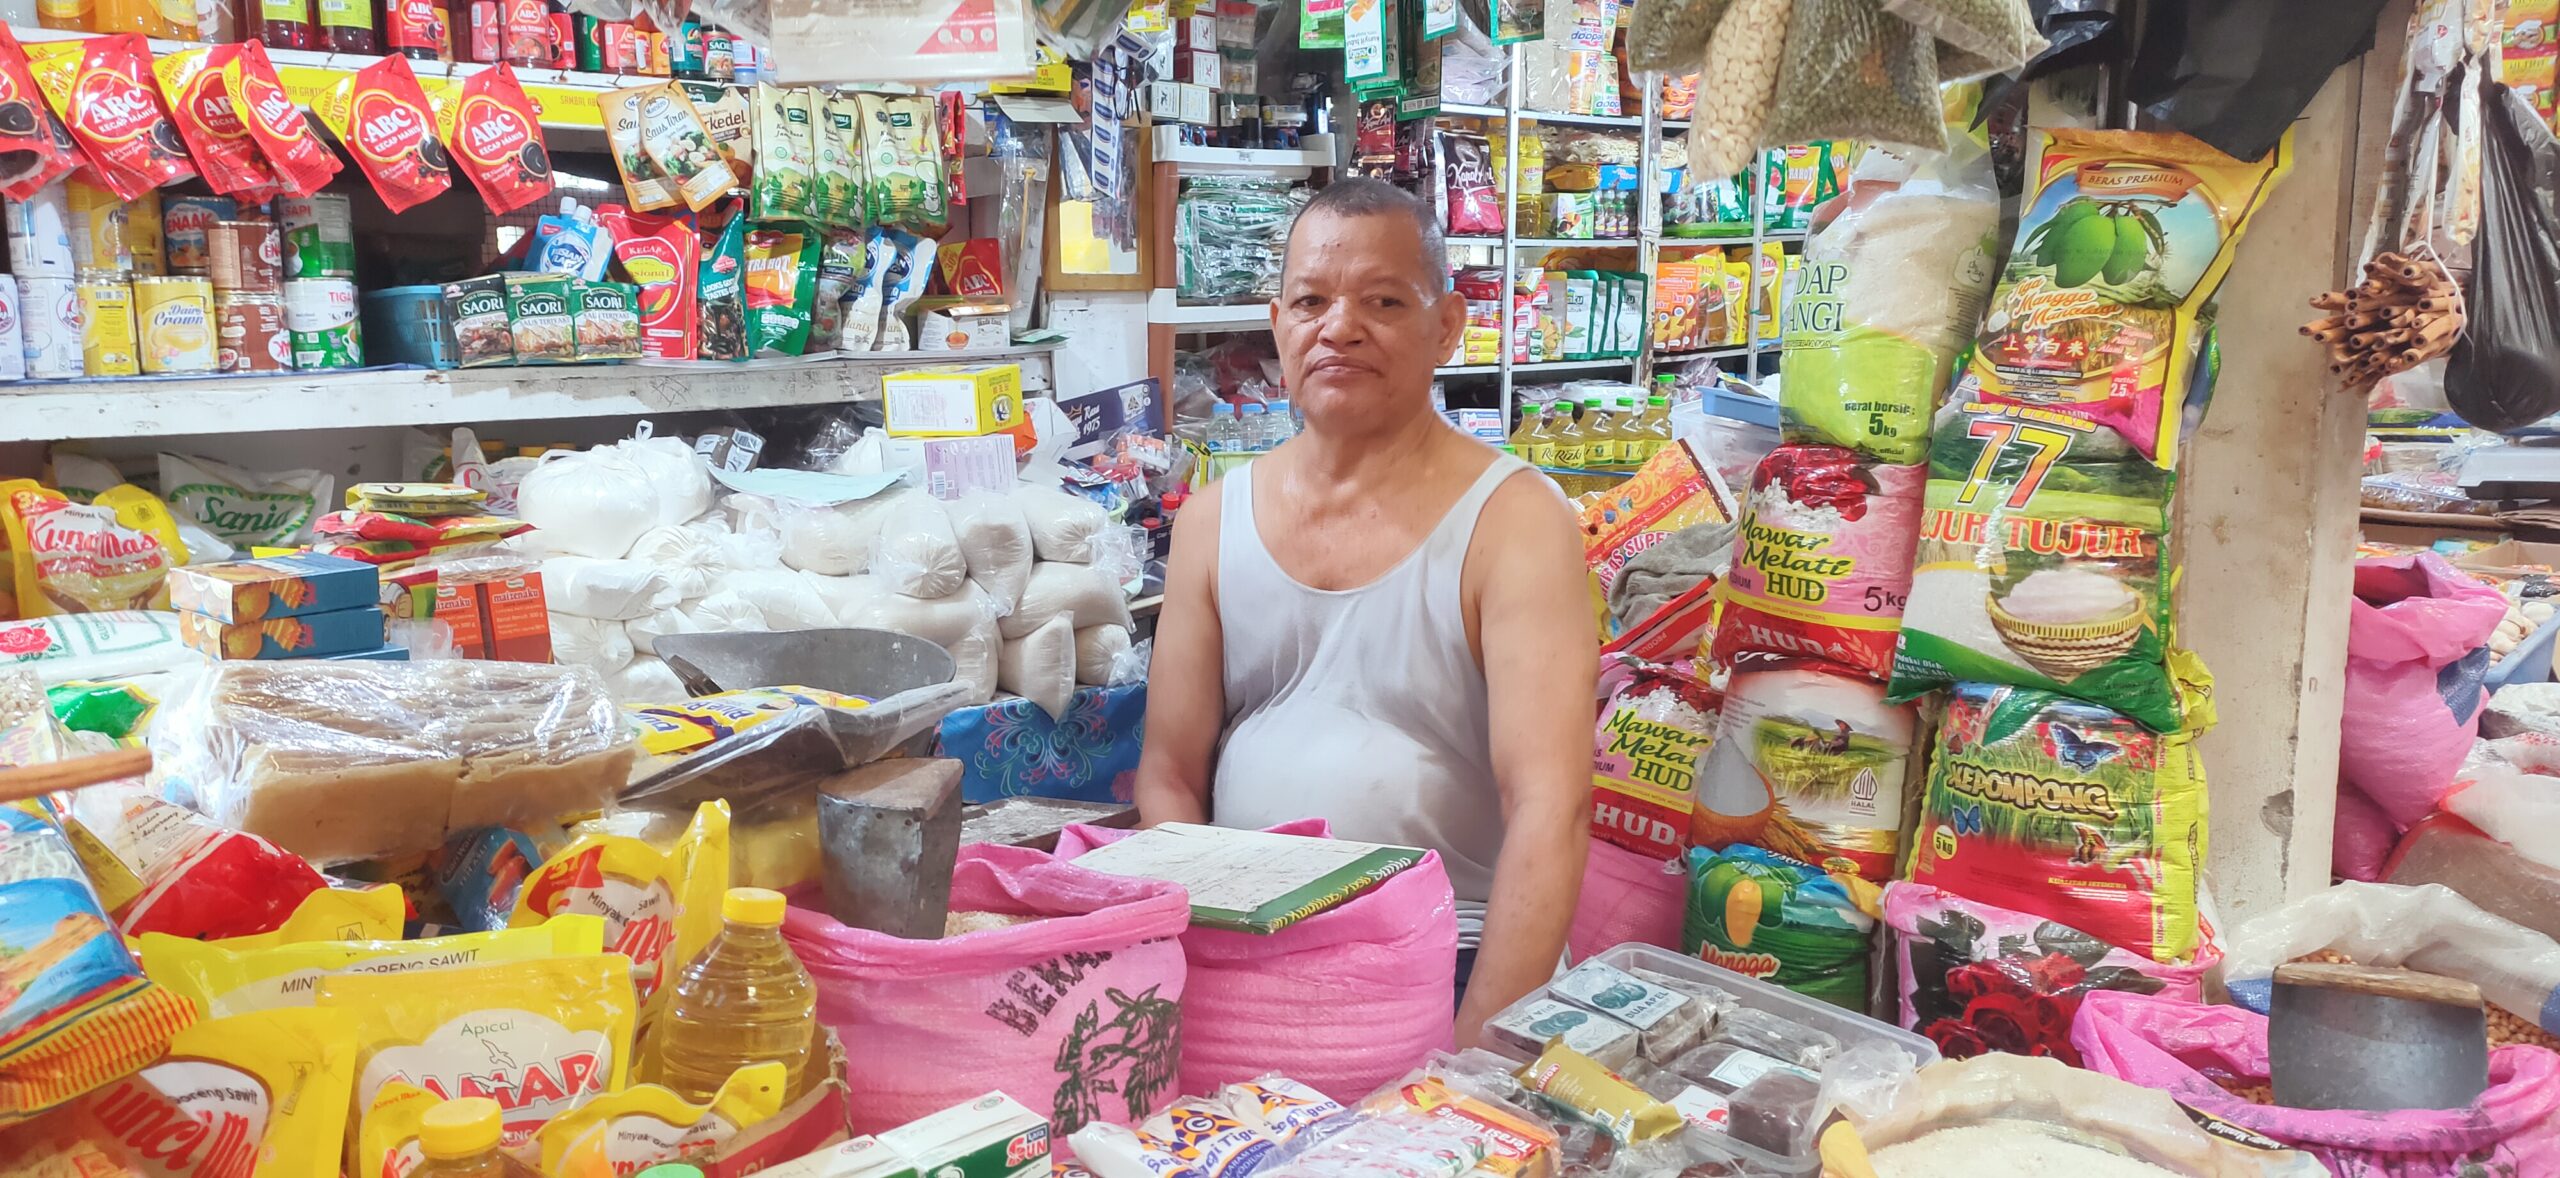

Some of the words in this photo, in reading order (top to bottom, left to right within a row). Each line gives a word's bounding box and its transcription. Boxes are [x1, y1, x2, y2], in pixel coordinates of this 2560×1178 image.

[408, 2, 432, 14] ABC
[519, 9, 537, 18] ABC
[90, 88, 149, 125] ABC
[203, 97, 234, 118] AB
[257, 90, 291, 125] ABC
[331, 92, 350, 125] 30%
[438, 97, 458, 127] 30%
[364, 107, 413, 144] ABC
[471, 113, 518, 148] ABC
[703, 109, 747, 134] rkedel
[2087, 174, 2125, 185] BERAS
[2125, 172, 2184, 187] PREMIUM
[629, 246, 665, 257] KECAP
[964, 275, 988, 292] ABC
[1796, 264, 1848, 296] DAP
[169, 302, 205, 317] Dairy
[462, 297, 504, 316] SAORI
[521, 301, 562, 316] SAORI
[586, 296, 623, 309] SAORI
[2014, 290, 2096, 318] Mangga
[153, 310, 206, 328] Crown
[1083, 420, 1101, 437] 1975
[1868, 413, 1884, 436] 5
[1883, 423, 1898, 438] kg
[1554, 448, 1584, 464] Rizki
[1957, 421, 2071, 510] 77
[196, 495, 291, 536] Sania
[1741, 506, 1831, 551] Mawar
[2004, 516, 2143, 558] TUJUH
[1743, 539, 1852, 577] Melati
[493, 588, 539, 603] maizenaku
[1766, 571, 1825, 603] HUD
[1863, 587, 1884, 612] 5
[437, 597, 472, 610] izenaku
[1749, 623, 1827, 657] HUD
[1604, 709, 1709, 749] Mawar
[1631, 760, 1694, 794] HUD
[1946, 762, 2119, 819] KEPOMPONG
[1850, 800, 1876, 810] HALAL
[1594, 801, 1677, 847] HUD
[1935, 837, 1945, 851] 5
[1945, 840, 1954, 856] kg
[587, 890, 623, 923] Minyak
[428, 949, 481, 969] SAWIT
[1699, 942, 1778, 978] Mangga
[1625, 1002, 1649, 1020] DUA
[1645, 989, 1671, 1010] APEL
[461, 1018, 515, 1038] Apical
[226, 1085, 259, 1106] Sawit
[93, 1084, 213, 1171] unci
[1437, 1105, 1486, 1136] Udang
[1005, 1137, 1048, 1168] SUN
[1491, 1128, 1532, 1153] Terasi
